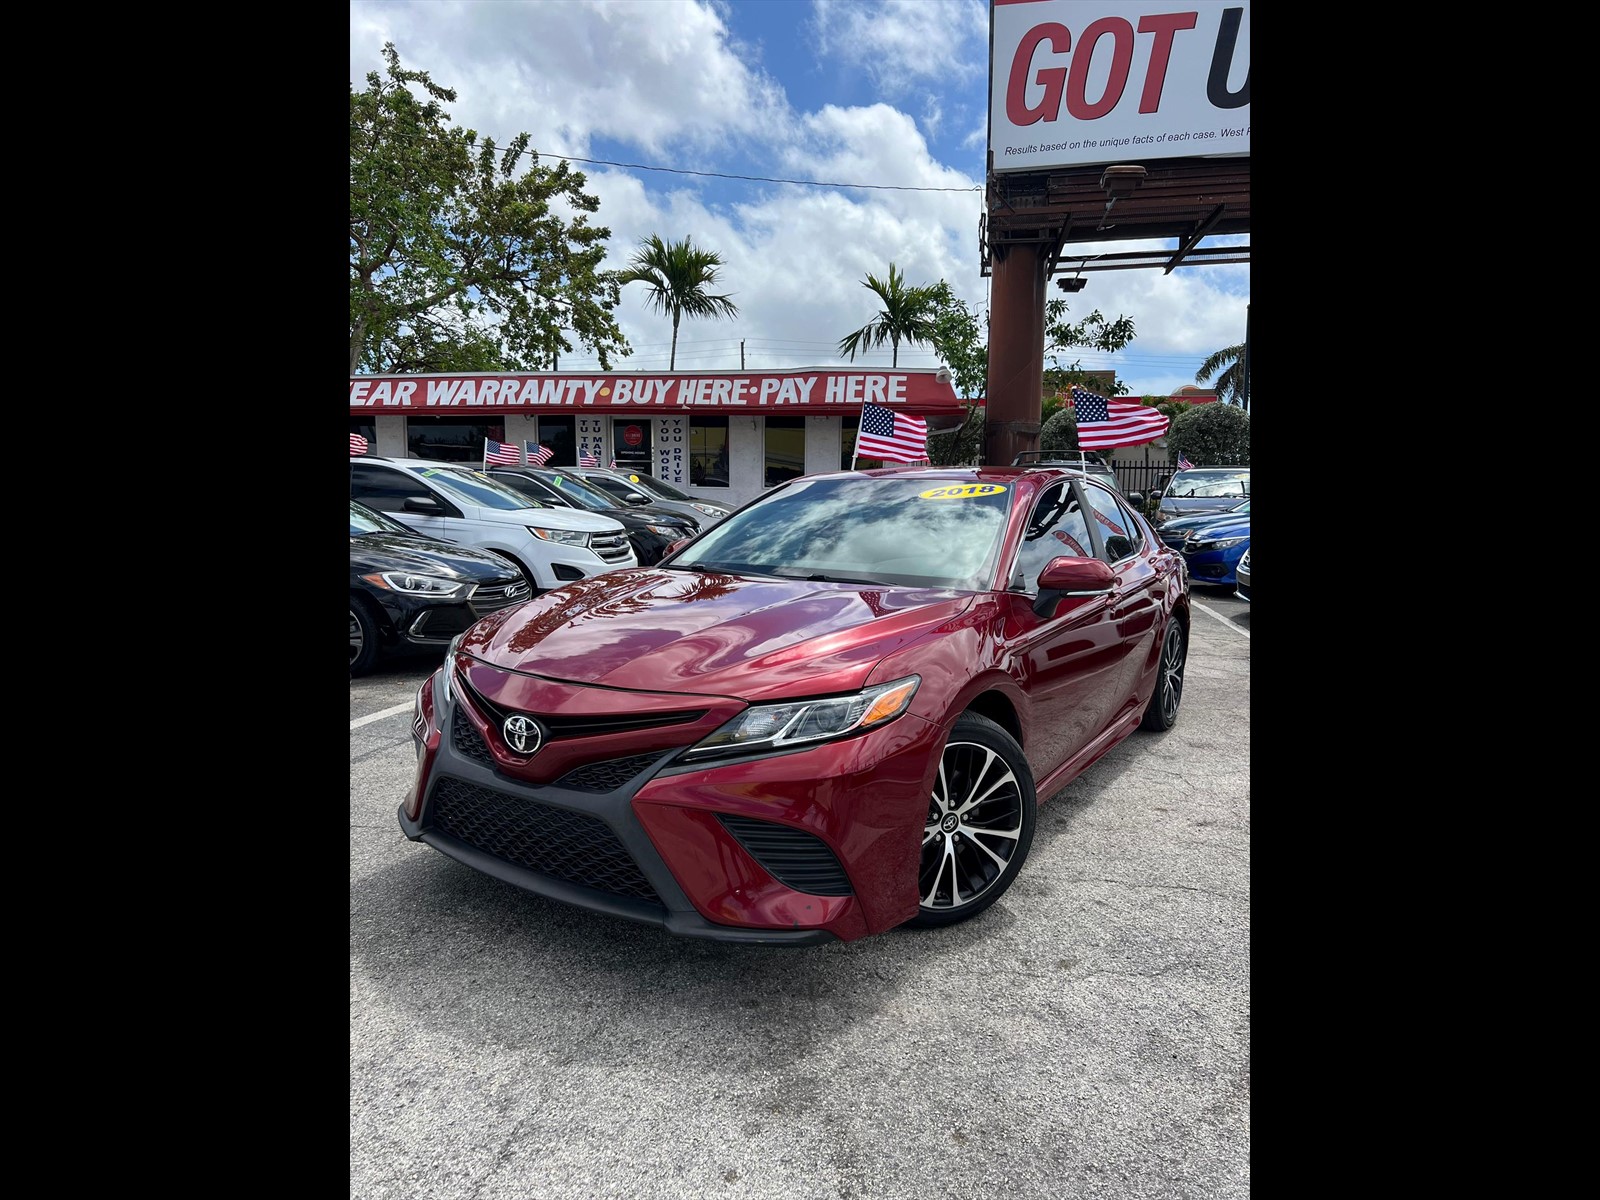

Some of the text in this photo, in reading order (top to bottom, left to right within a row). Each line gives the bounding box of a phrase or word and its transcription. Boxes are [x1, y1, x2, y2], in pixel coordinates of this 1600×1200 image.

[1005, 7, 1250, 126] GOT U
[1005, 144, 1037, 155] Results
[1039, 141, 1067, 152] based
[1069, 141, 1080, 149] on
[1083, 138, 1097, 148] the
[1099, 137, 1130, 147] unique
[1132, 135, 1154, 144] facts
[1156, 133, 1167, 142] of
[1167, 131, 1190, 141] each
[1192, 131, 1217, 140] case.
[1220, 127, 1244, 137] West
[426, 379, 606, 406] WARRANTY
[611, 379, 676, 405] BUY
[676, 378, 750, 405] HERE
[759, 377, 818, 405] PAY
[825, 375, 908, 403] HERE
[580, 420, 589, 433] TU
[593, 420, 601, 433] TU
[660, 419, 670, 480] YOU WORK
[673, 419, 682, 483] YOU DRIVE
[929, 486, 996, 497] 2018
